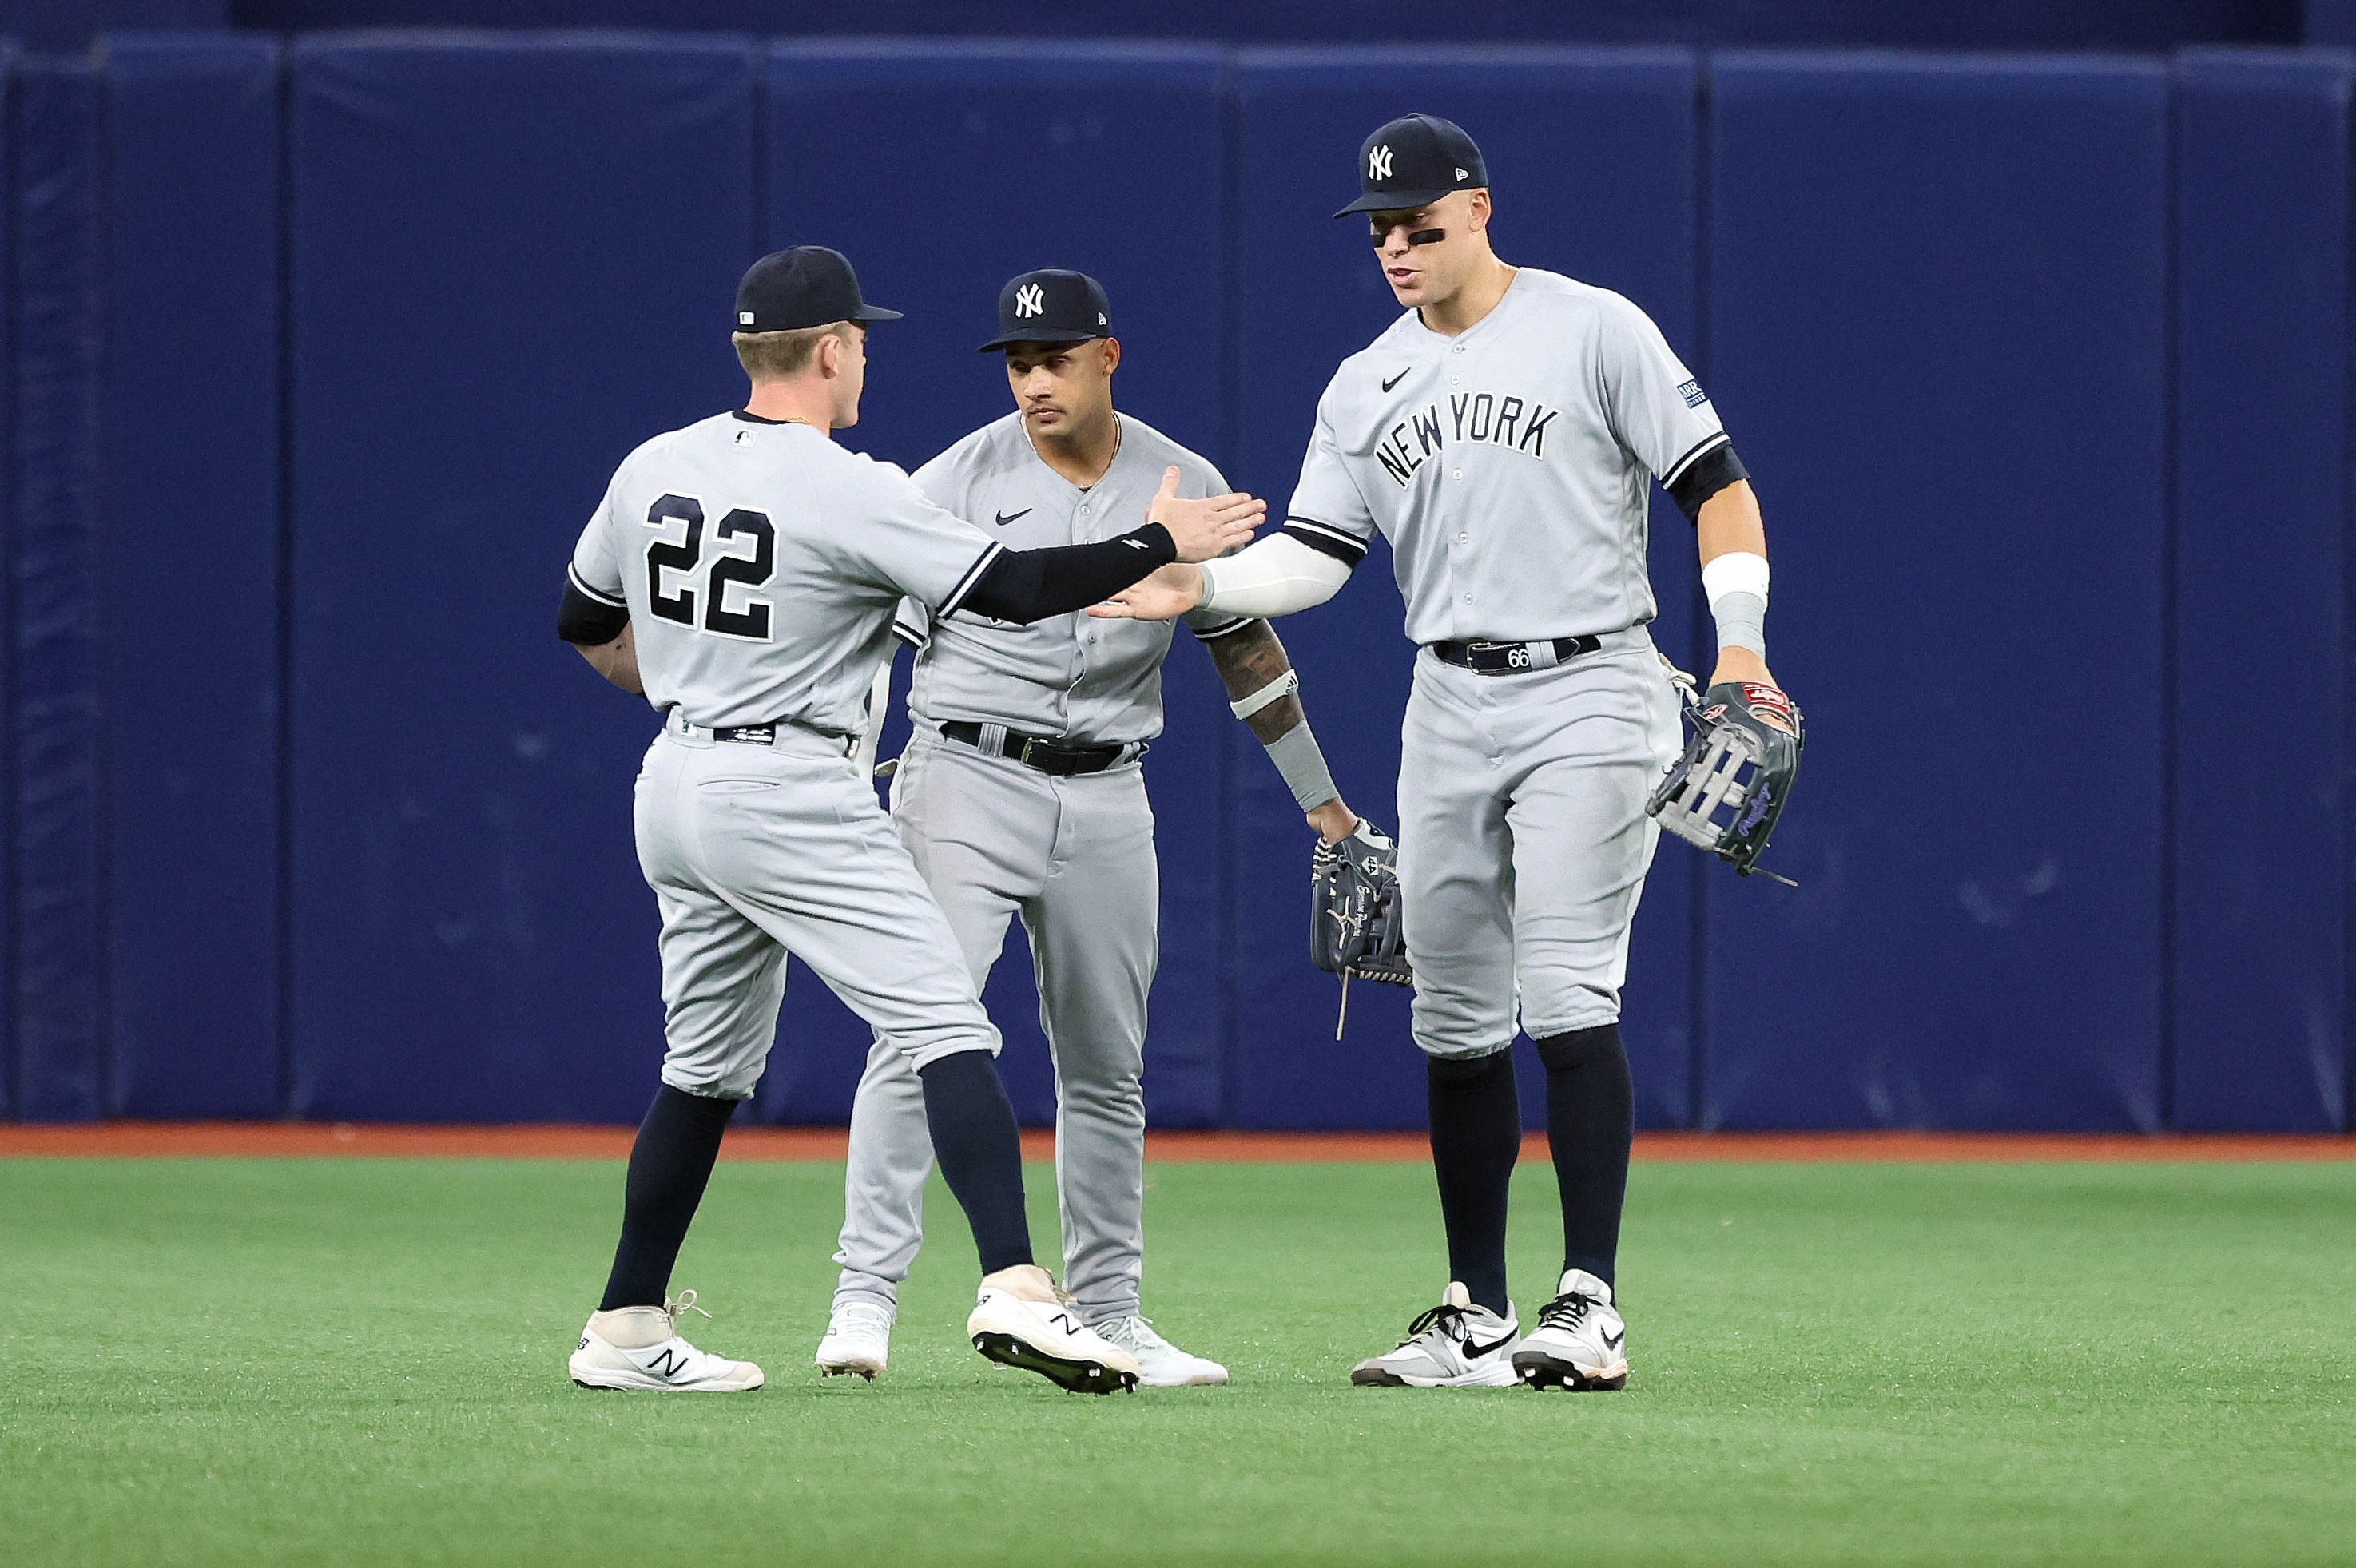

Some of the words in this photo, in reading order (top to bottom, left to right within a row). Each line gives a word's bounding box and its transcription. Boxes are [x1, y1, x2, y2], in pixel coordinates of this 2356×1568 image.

[1368, 145, 1394, 181] NY
[1015, 282, 1045, 318] NY
[1373, 402, 1443, 491] NEW
[1448, 390, 1563, 461] YORK
[644, 490, 779, 643] 22
[1508, 648, 1529, 668] 66
